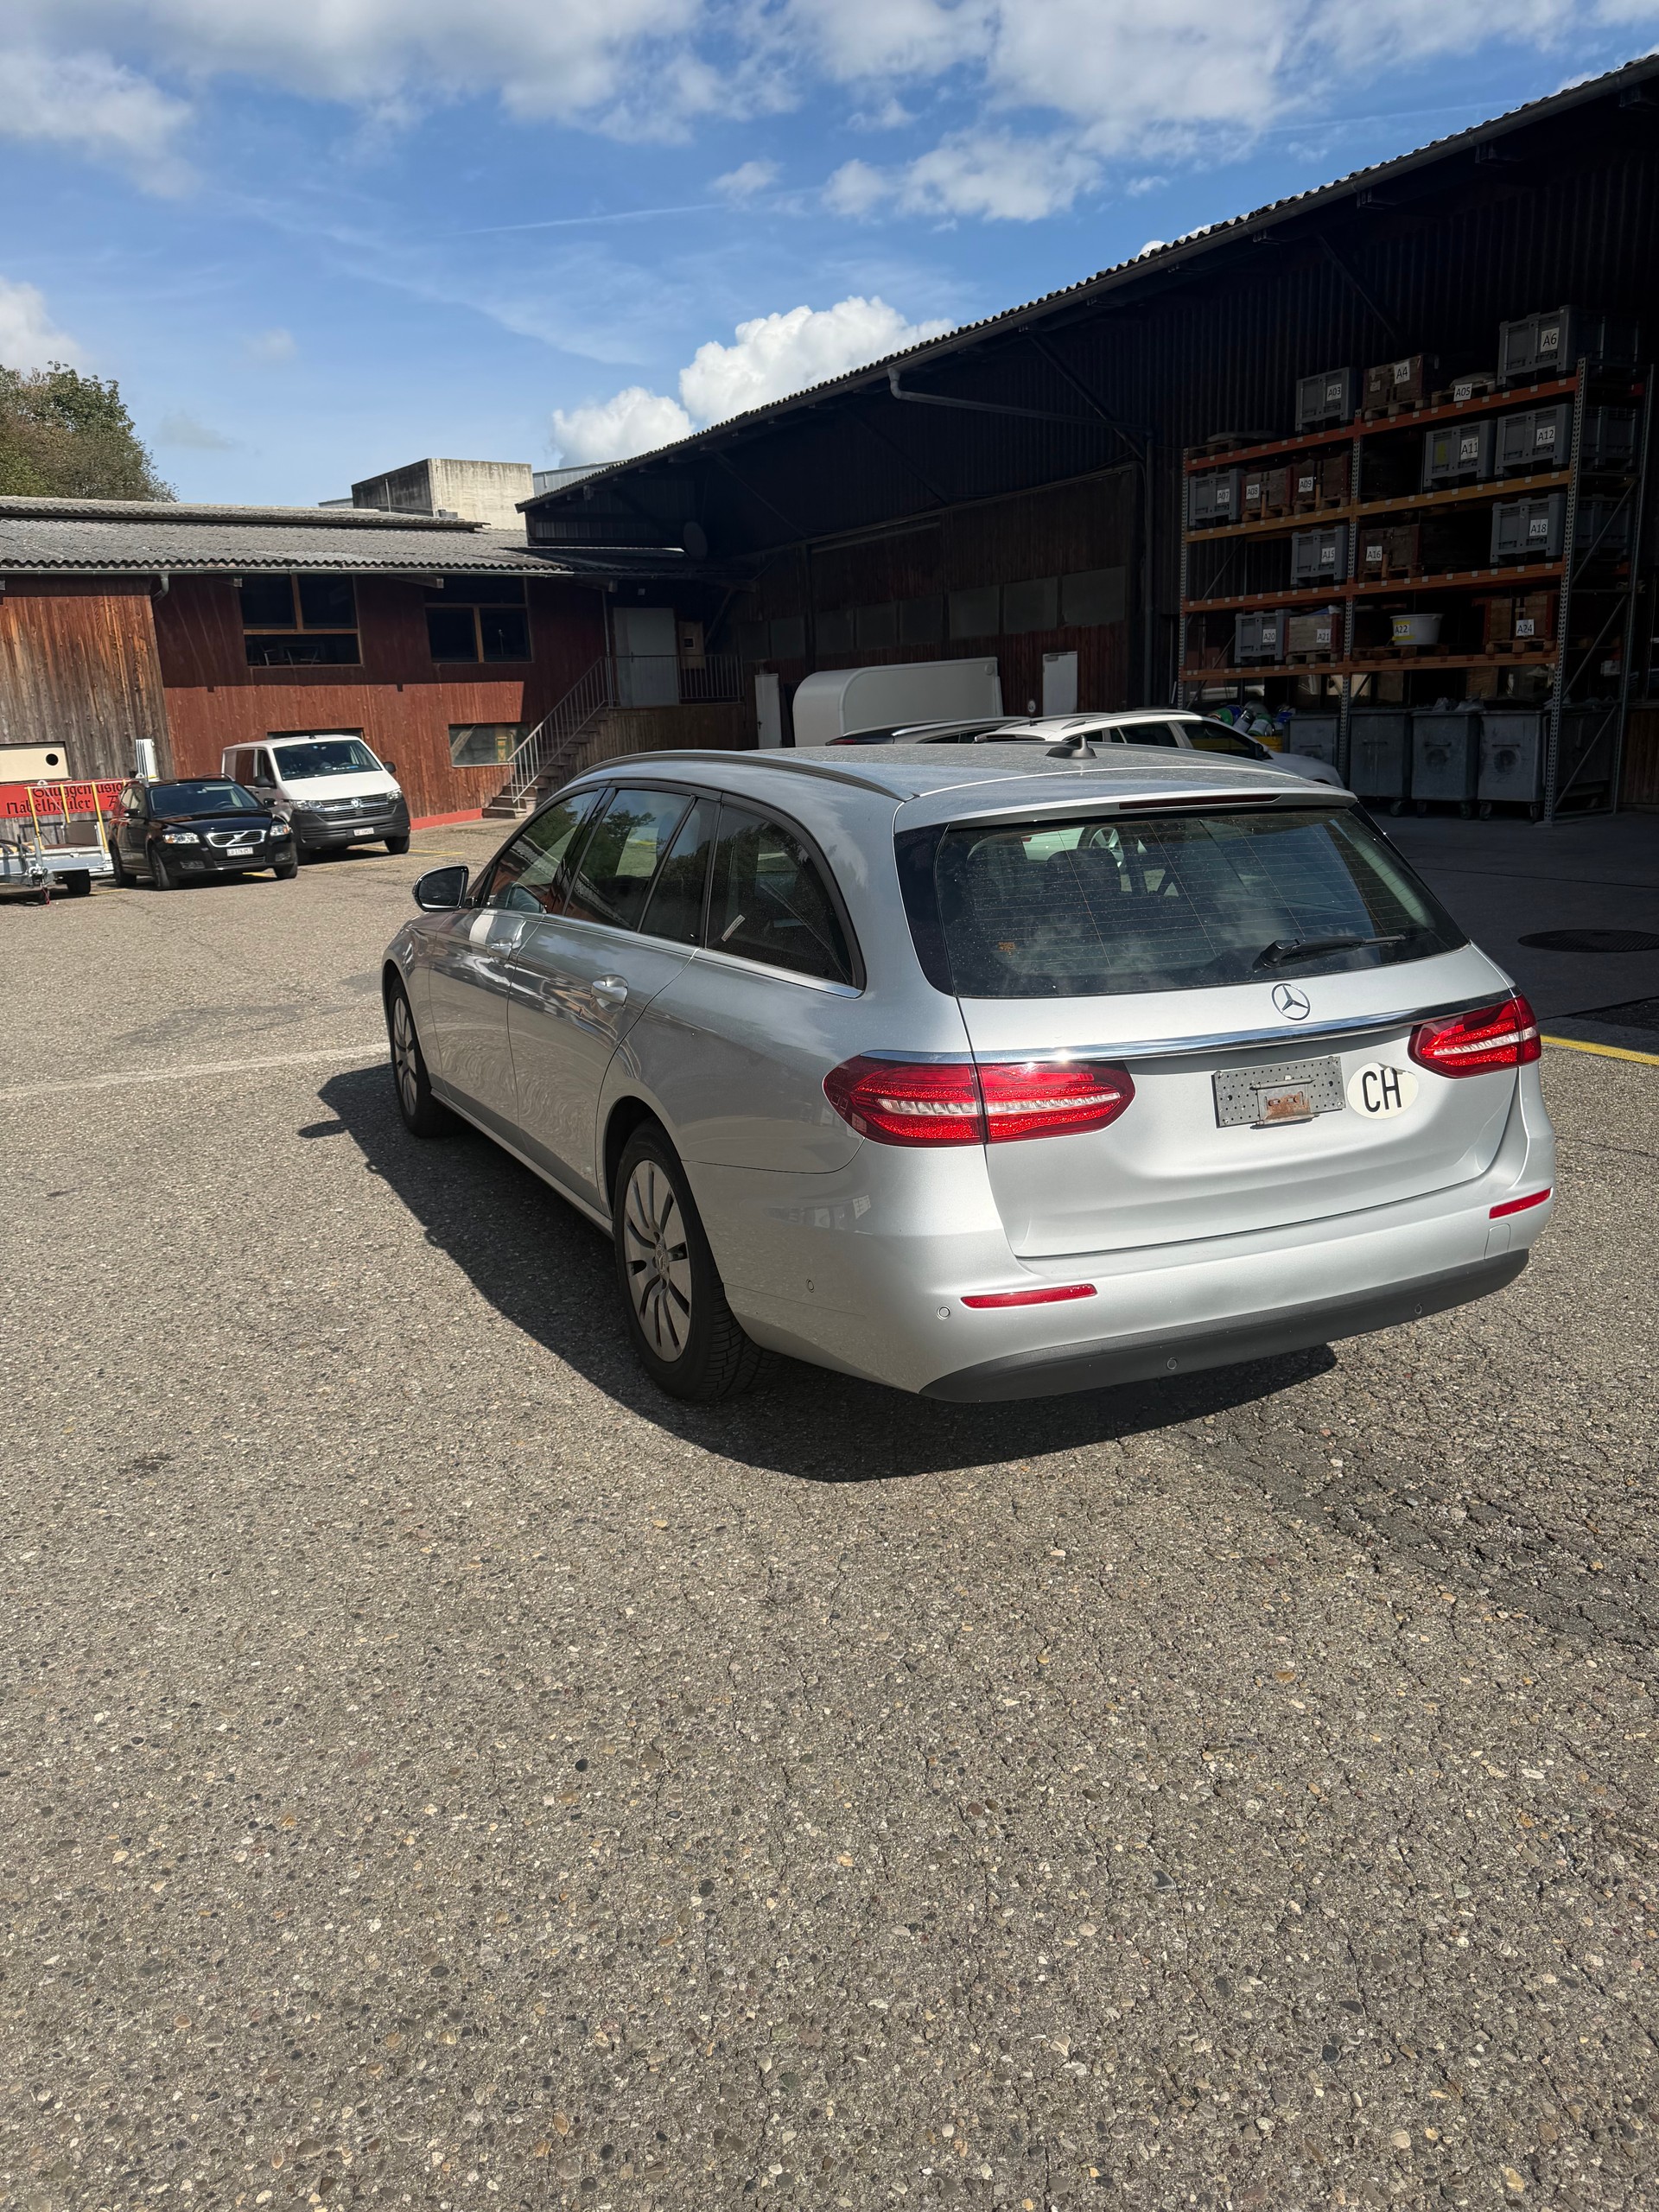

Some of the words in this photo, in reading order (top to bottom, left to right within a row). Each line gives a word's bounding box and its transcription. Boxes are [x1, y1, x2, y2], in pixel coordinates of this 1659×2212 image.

[1542, 333, 1557, 347] A6
[1395, 366, 1408, 379] A4
[1328, 386, 1341, 397] A03
[1455, 386, 1471, 397] A05
[1538, 429, 1554, 442] A12
[1461, 442, 1478, 454] A11
[1300, 480, 1312, 489] A09
[1218, 491, 1229, 500] A07
[1531, 524, 1547, 533] A18
[1323, 550, 1334, 560] A15
[1368, 550, 1381, 559] A16
[1395, 625, 1408, 634] A22
[1516, 624, 1532, 633] A24
[1264, 632, 1274, 641] A20
[1318, 632, 1329, 641] A21
[1362, 1068, 1402, 1113] CH
